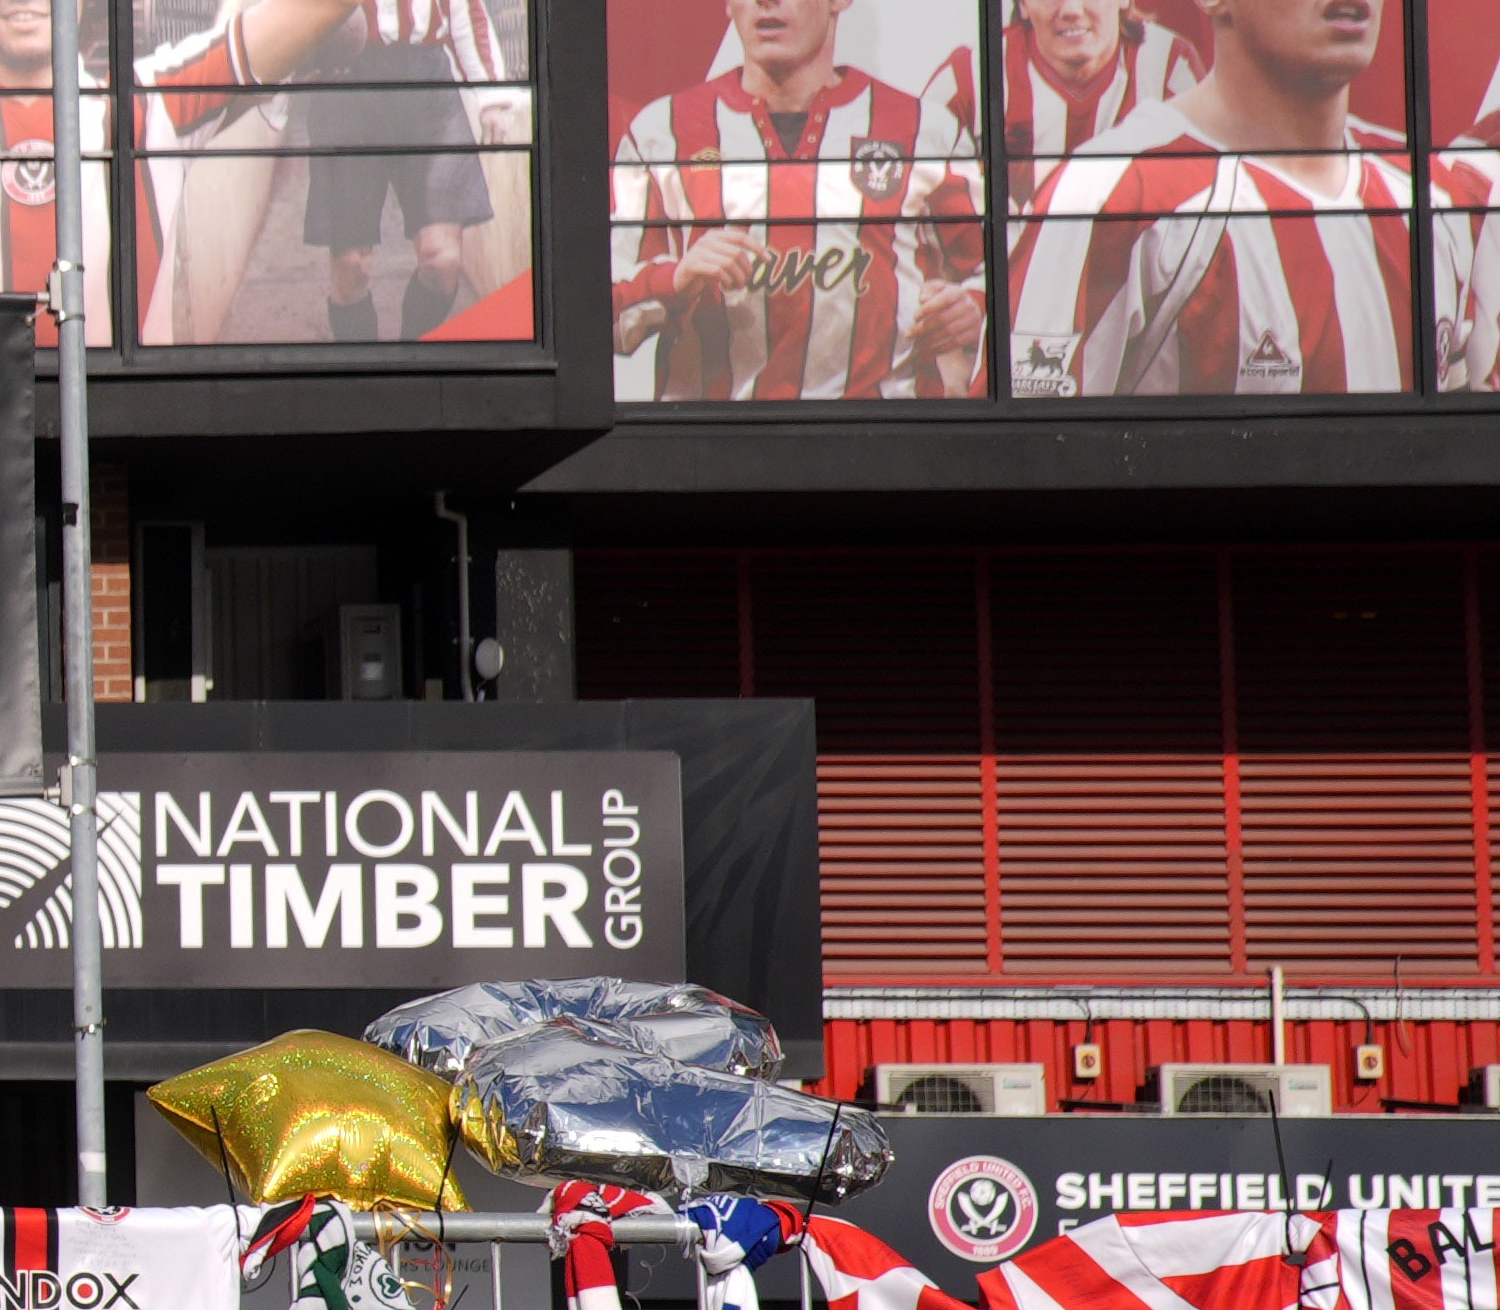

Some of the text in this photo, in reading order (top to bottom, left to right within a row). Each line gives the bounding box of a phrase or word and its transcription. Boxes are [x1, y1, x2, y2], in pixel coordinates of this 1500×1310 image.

[154, 788, 593, 858] NATIONAL
[155, 863, 593, 950] TIMBER
[603, 788, 643, 950] GROUP
[1056, 1172, 1332, 1209] SHEFFIELD
